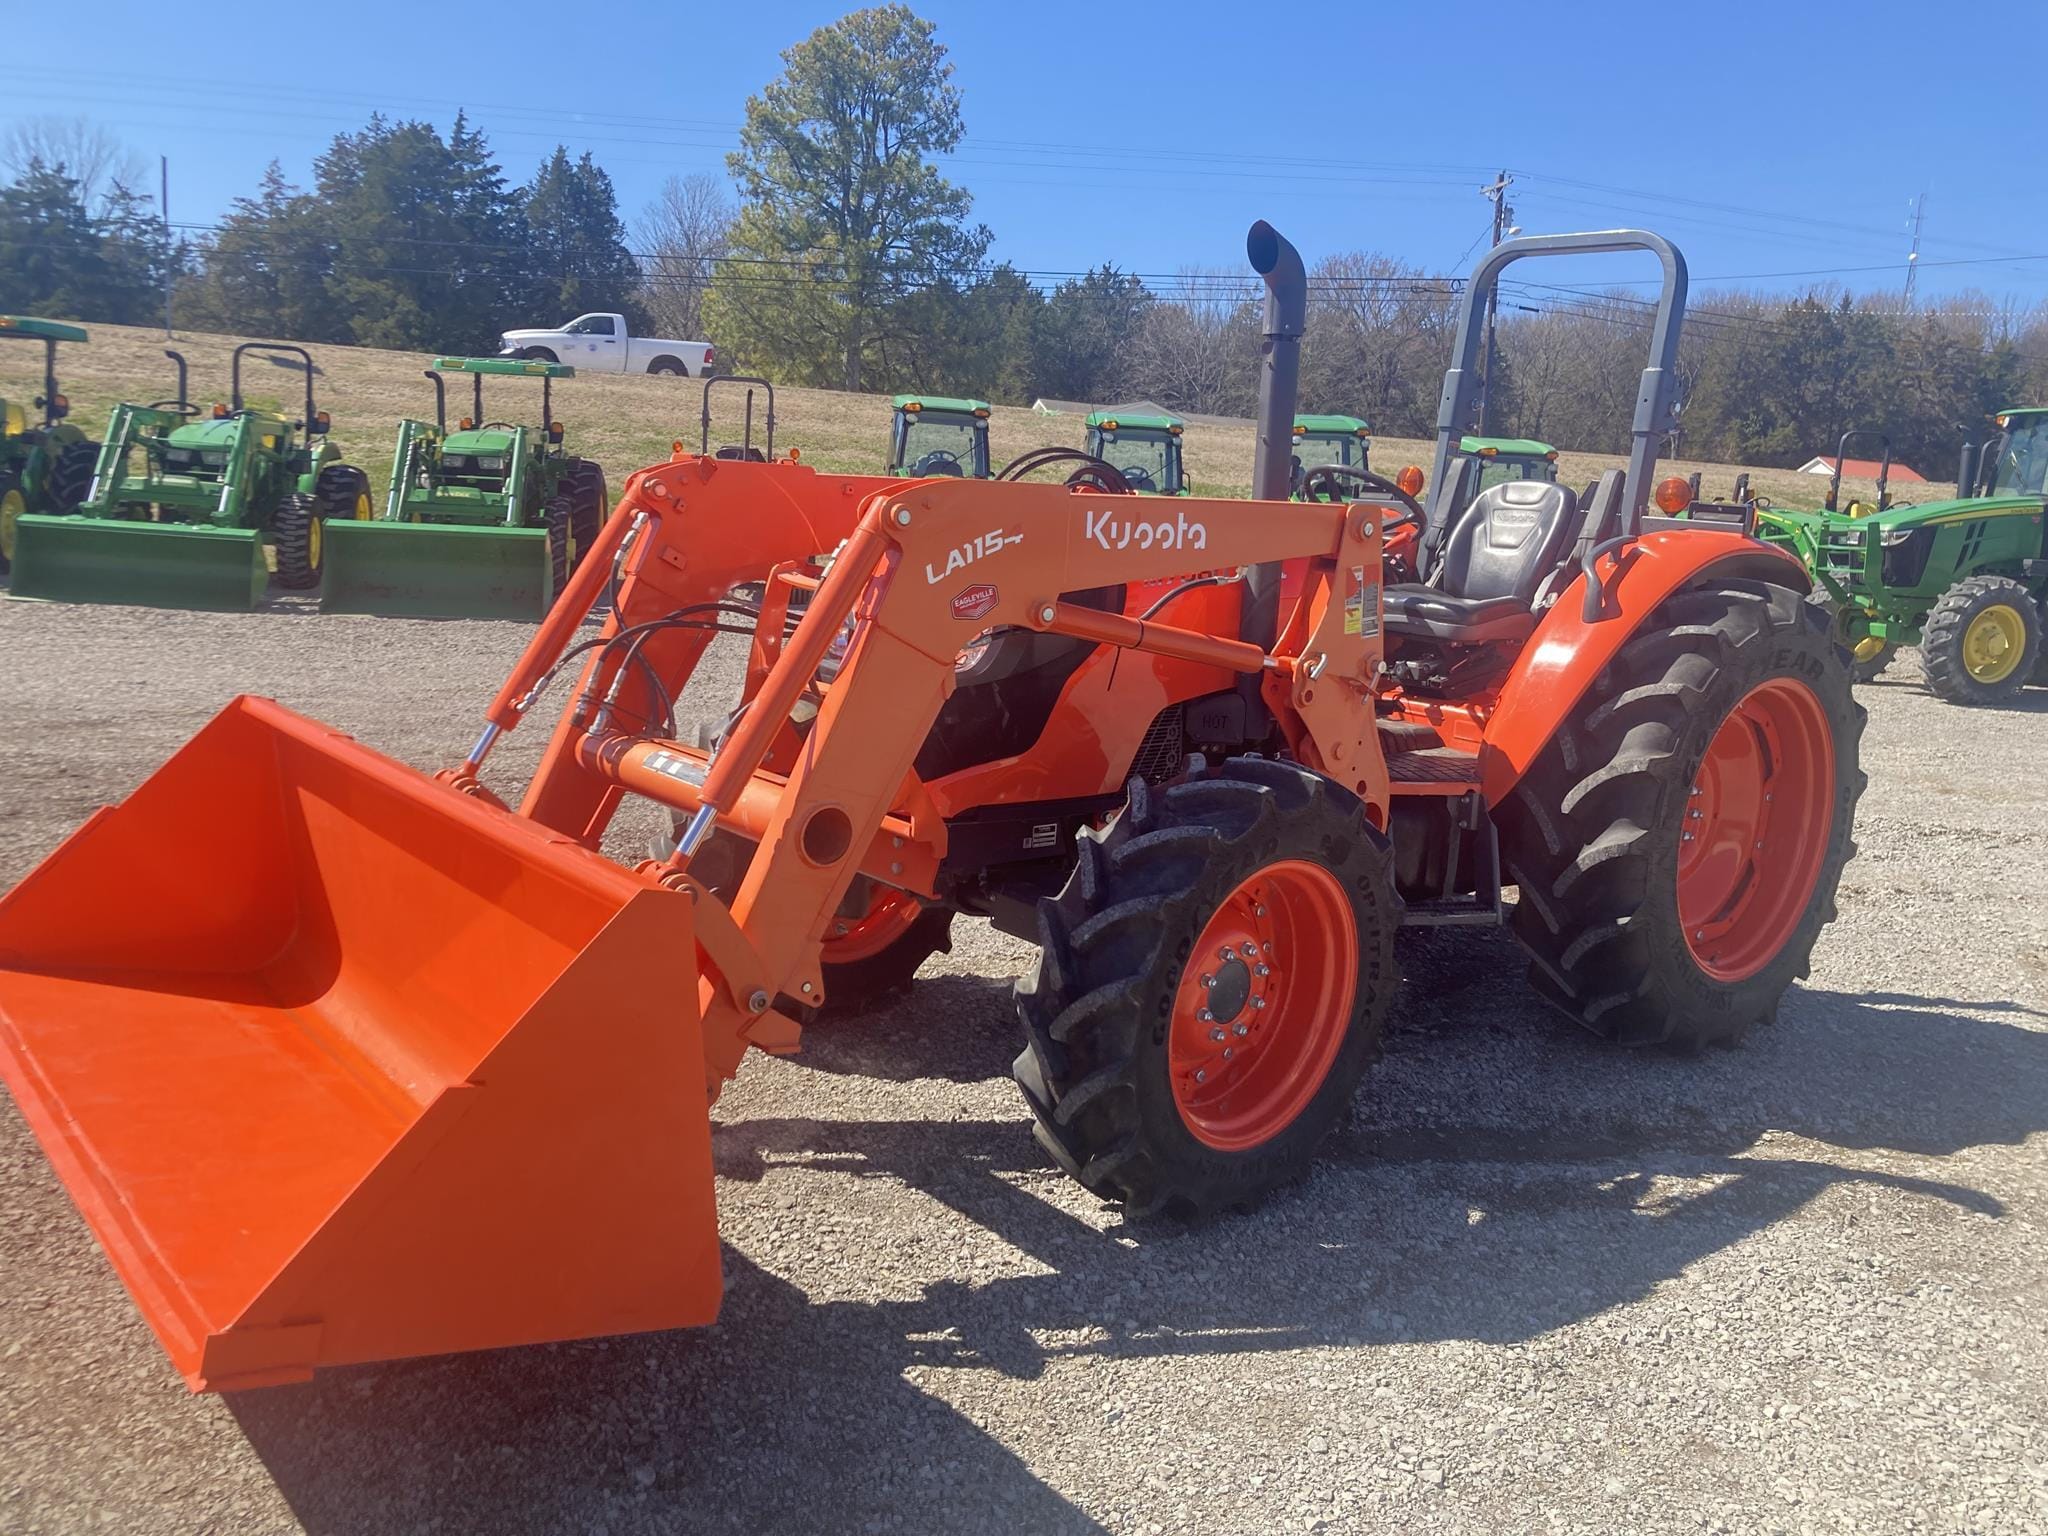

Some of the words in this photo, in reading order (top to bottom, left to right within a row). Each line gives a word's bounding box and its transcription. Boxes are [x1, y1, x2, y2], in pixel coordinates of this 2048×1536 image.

[1086, 510, 1207, 550] Kubota
[954, 588, 994, 607] EAGLEVILLE
[1202, 714, 1229, 729] HOT
